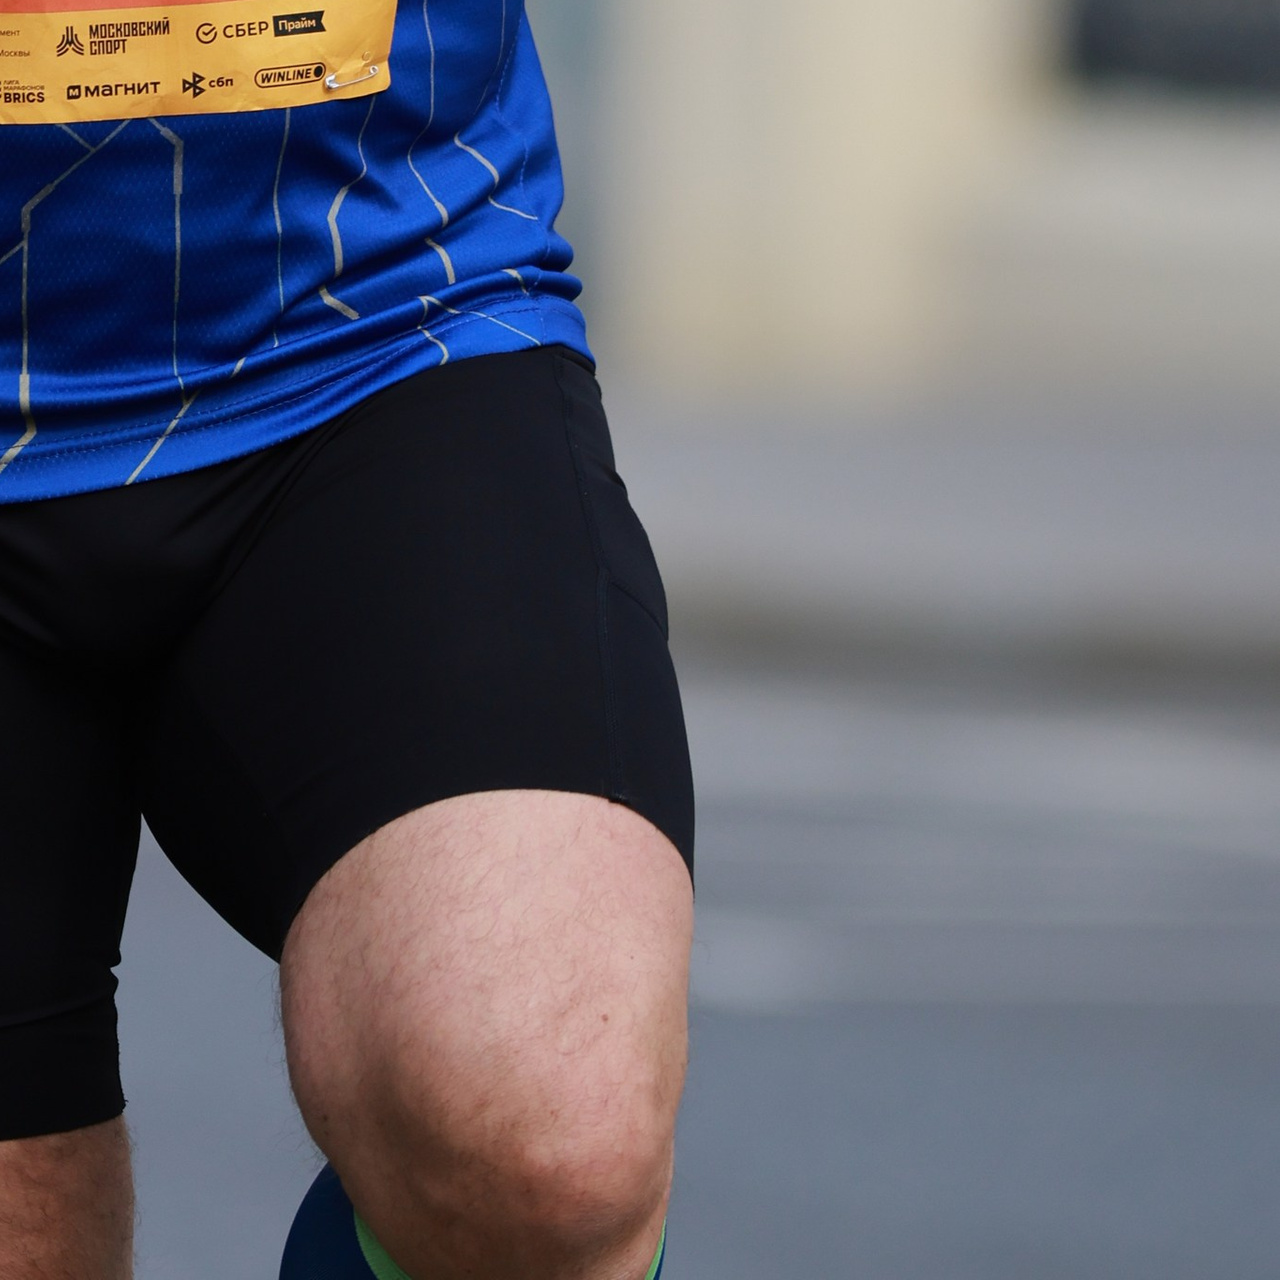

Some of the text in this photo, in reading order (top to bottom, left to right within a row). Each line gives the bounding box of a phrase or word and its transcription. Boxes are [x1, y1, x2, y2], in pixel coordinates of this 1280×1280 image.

[89, 16, 170, 40] МОСКОВСКИЙ
[222, 21, 269, 39] СБЕР
[278, 17, 317, 33] Прайм
[89, 39, 128, 56] СПОРТ
[260, 67, 312, 85] WINLINE
[3, 92, 45, 103] BRICS
